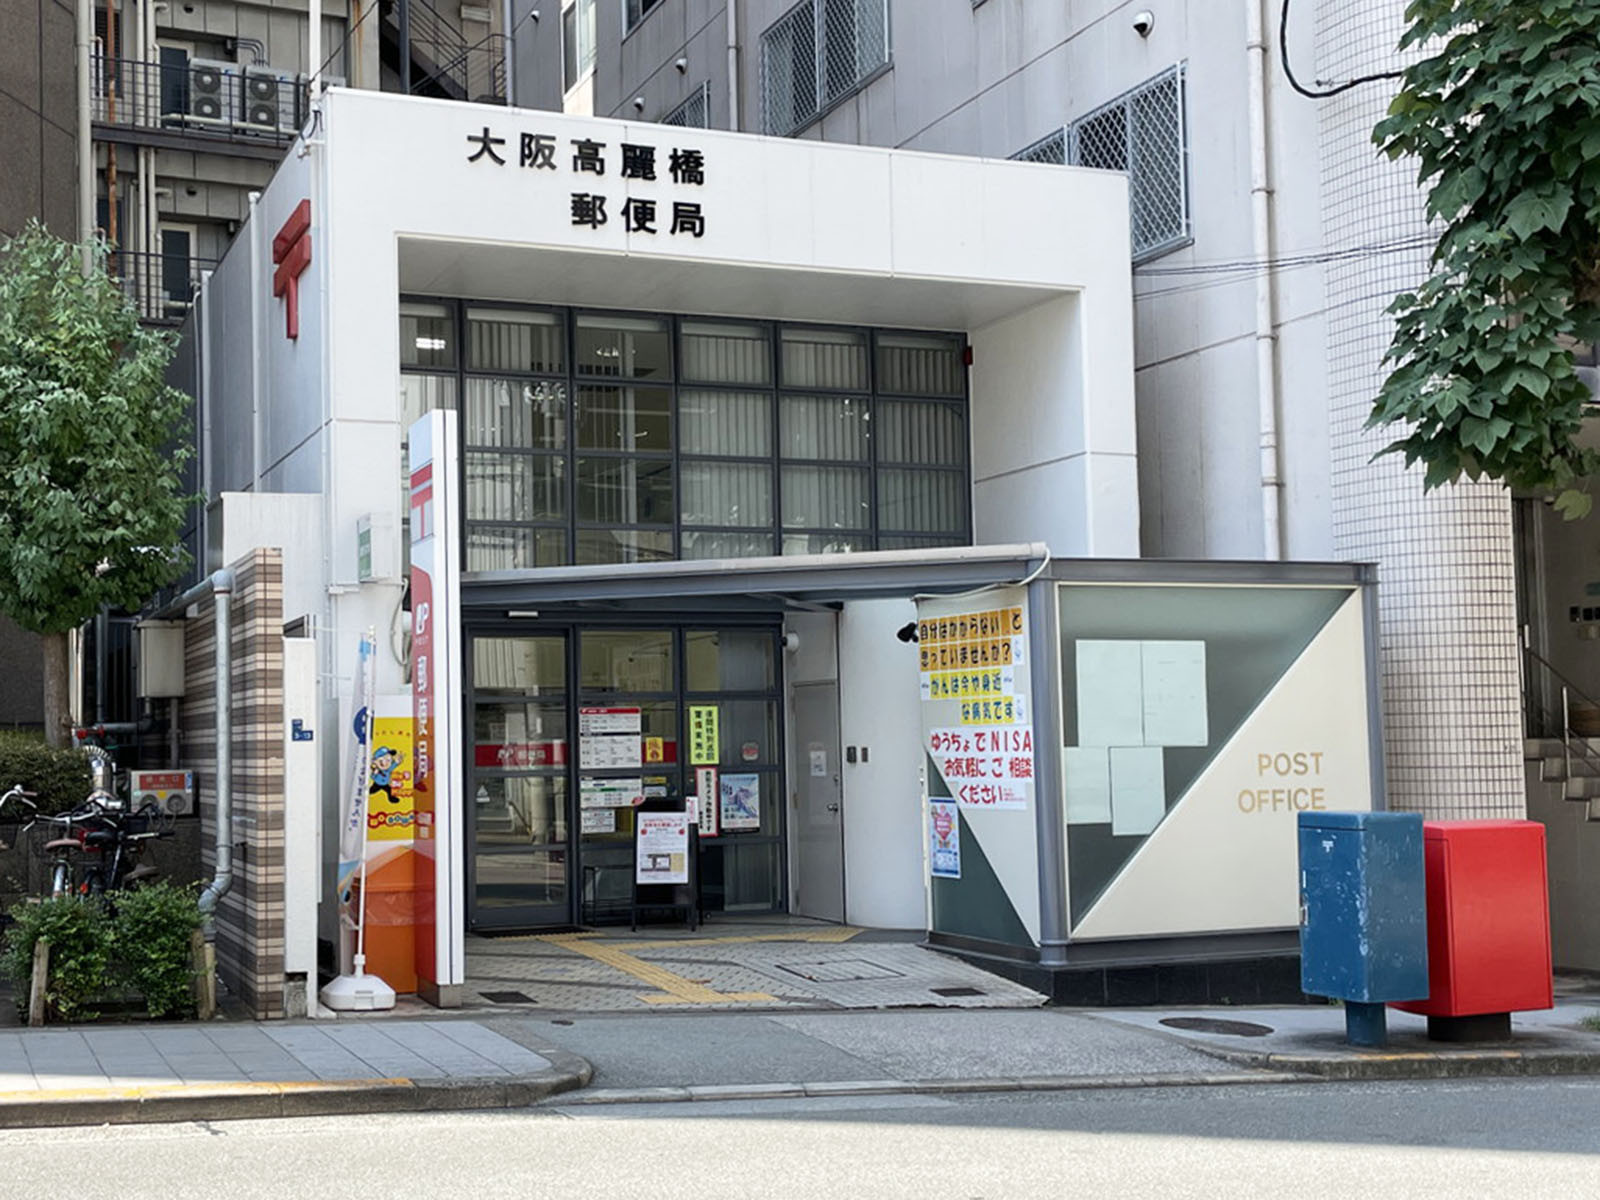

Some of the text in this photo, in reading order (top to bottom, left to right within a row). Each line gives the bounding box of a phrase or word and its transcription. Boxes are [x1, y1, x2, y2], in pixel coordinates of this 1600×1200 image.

[467, 127, 705, 185] 大阪高麗橋
[570, 193, 705, 237] 郵便局
[1257, 752, 1323, 776] POST
[959, 785, 1003, 804] ください
[1238, 788, 1326, 813] OFFICE
